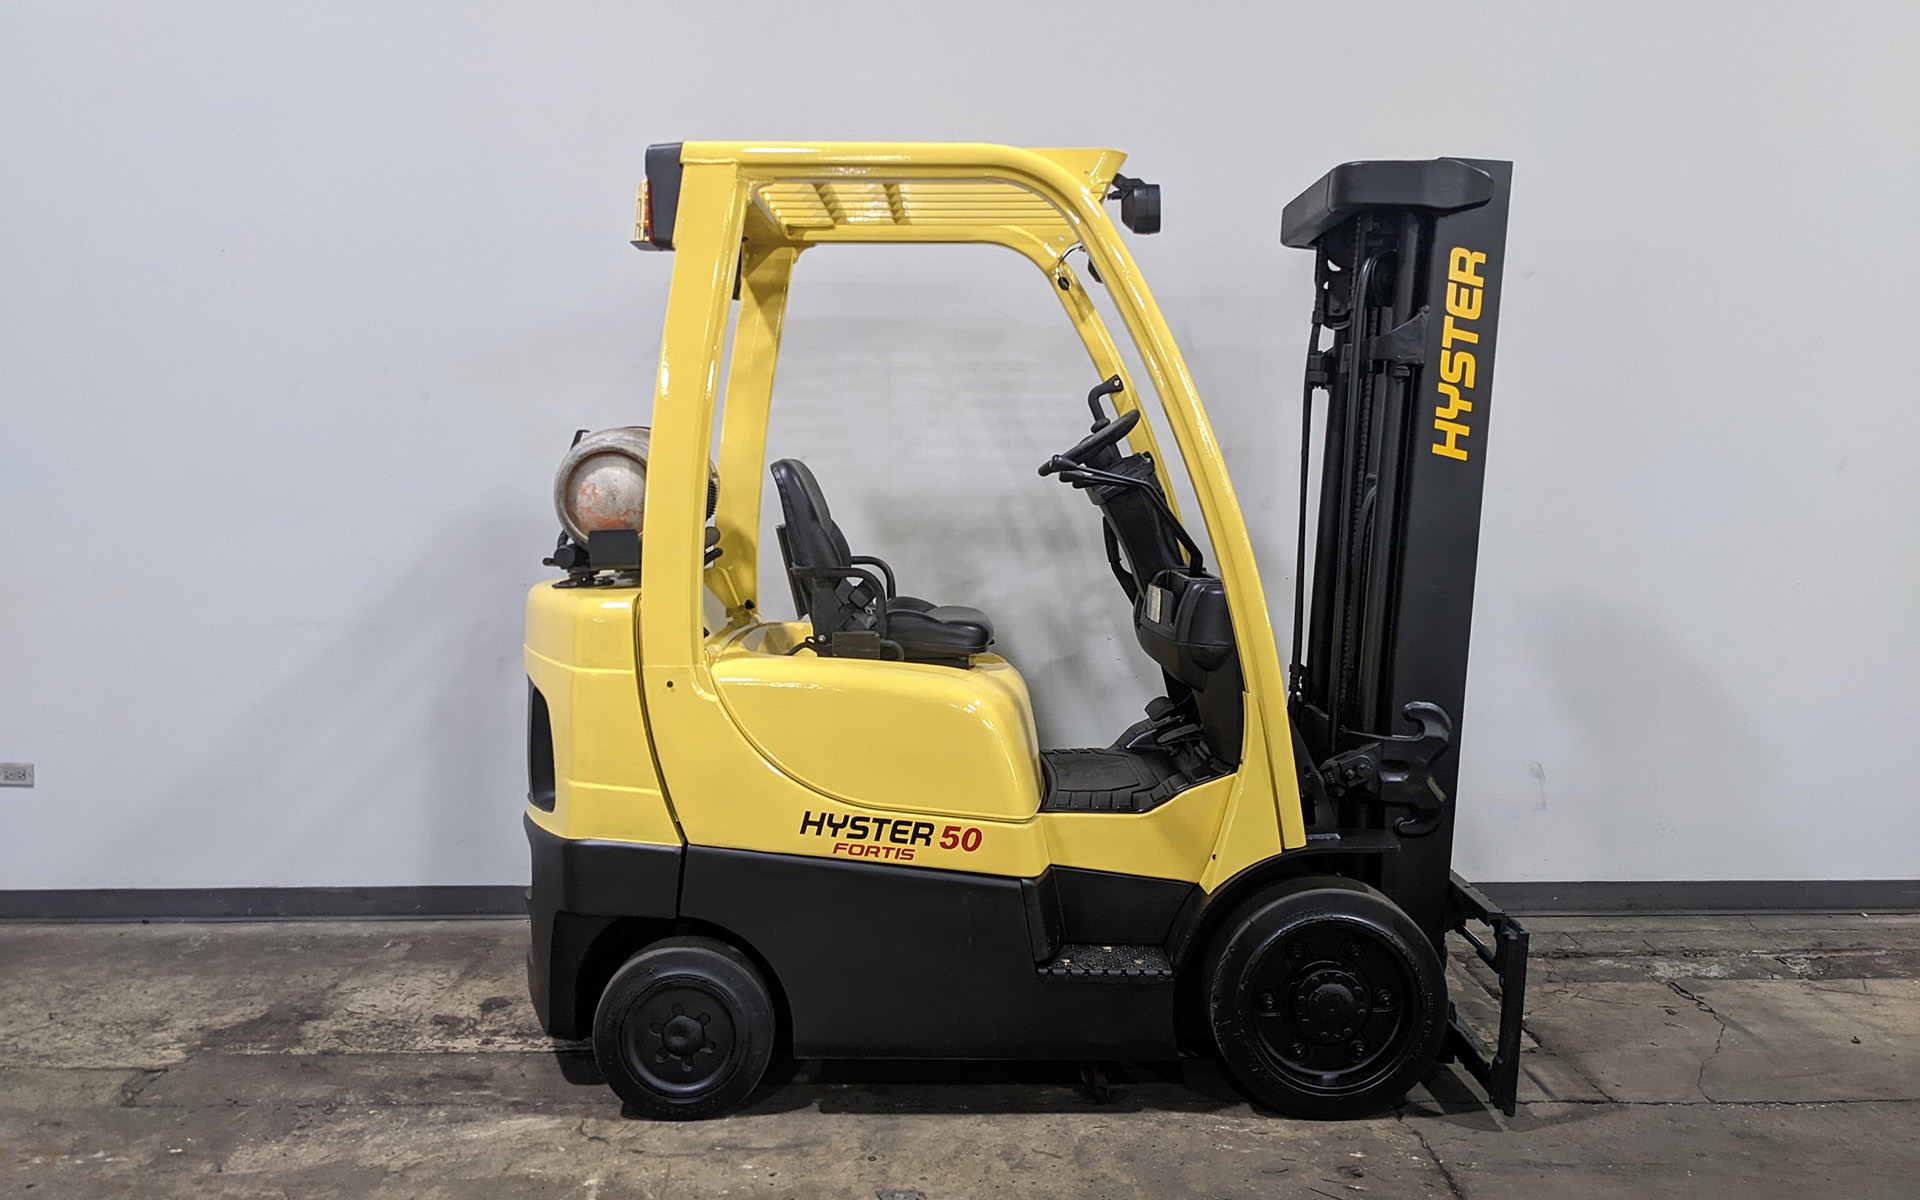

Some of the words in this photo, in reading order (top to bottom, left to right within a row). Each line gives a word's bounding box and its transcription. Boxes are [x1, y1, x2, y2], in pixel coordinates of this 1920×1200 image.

[1432, 247, 1487, 461] HYSTER
[800, 811, 935, 846] HYSTER
[939, 825, 983, 852] 50
[832, 843, 915, 861] FORTIS
